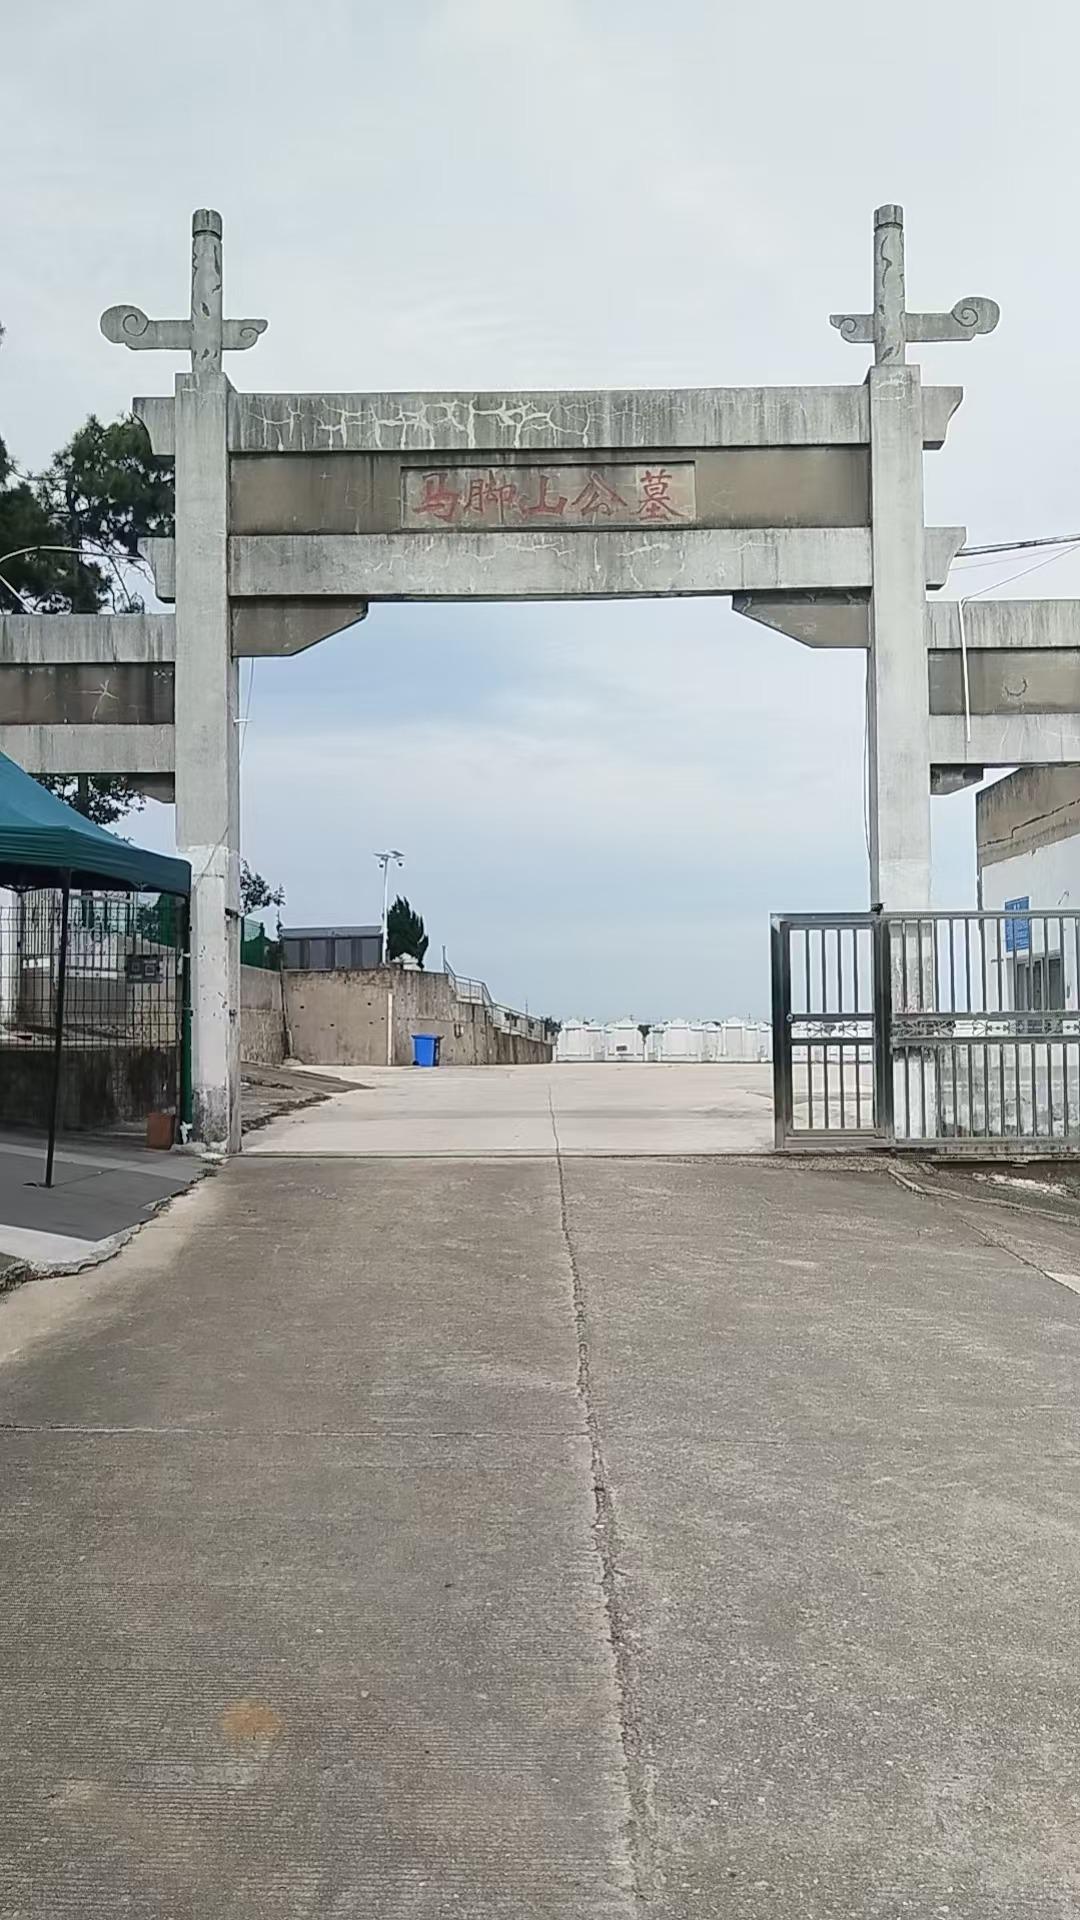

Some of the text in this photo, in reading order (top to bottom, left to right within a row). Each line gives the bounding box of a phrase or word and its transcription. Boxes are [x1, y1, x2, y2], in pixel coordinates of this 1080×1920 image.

[412, 469, 685, 522] 马脚山公墓
